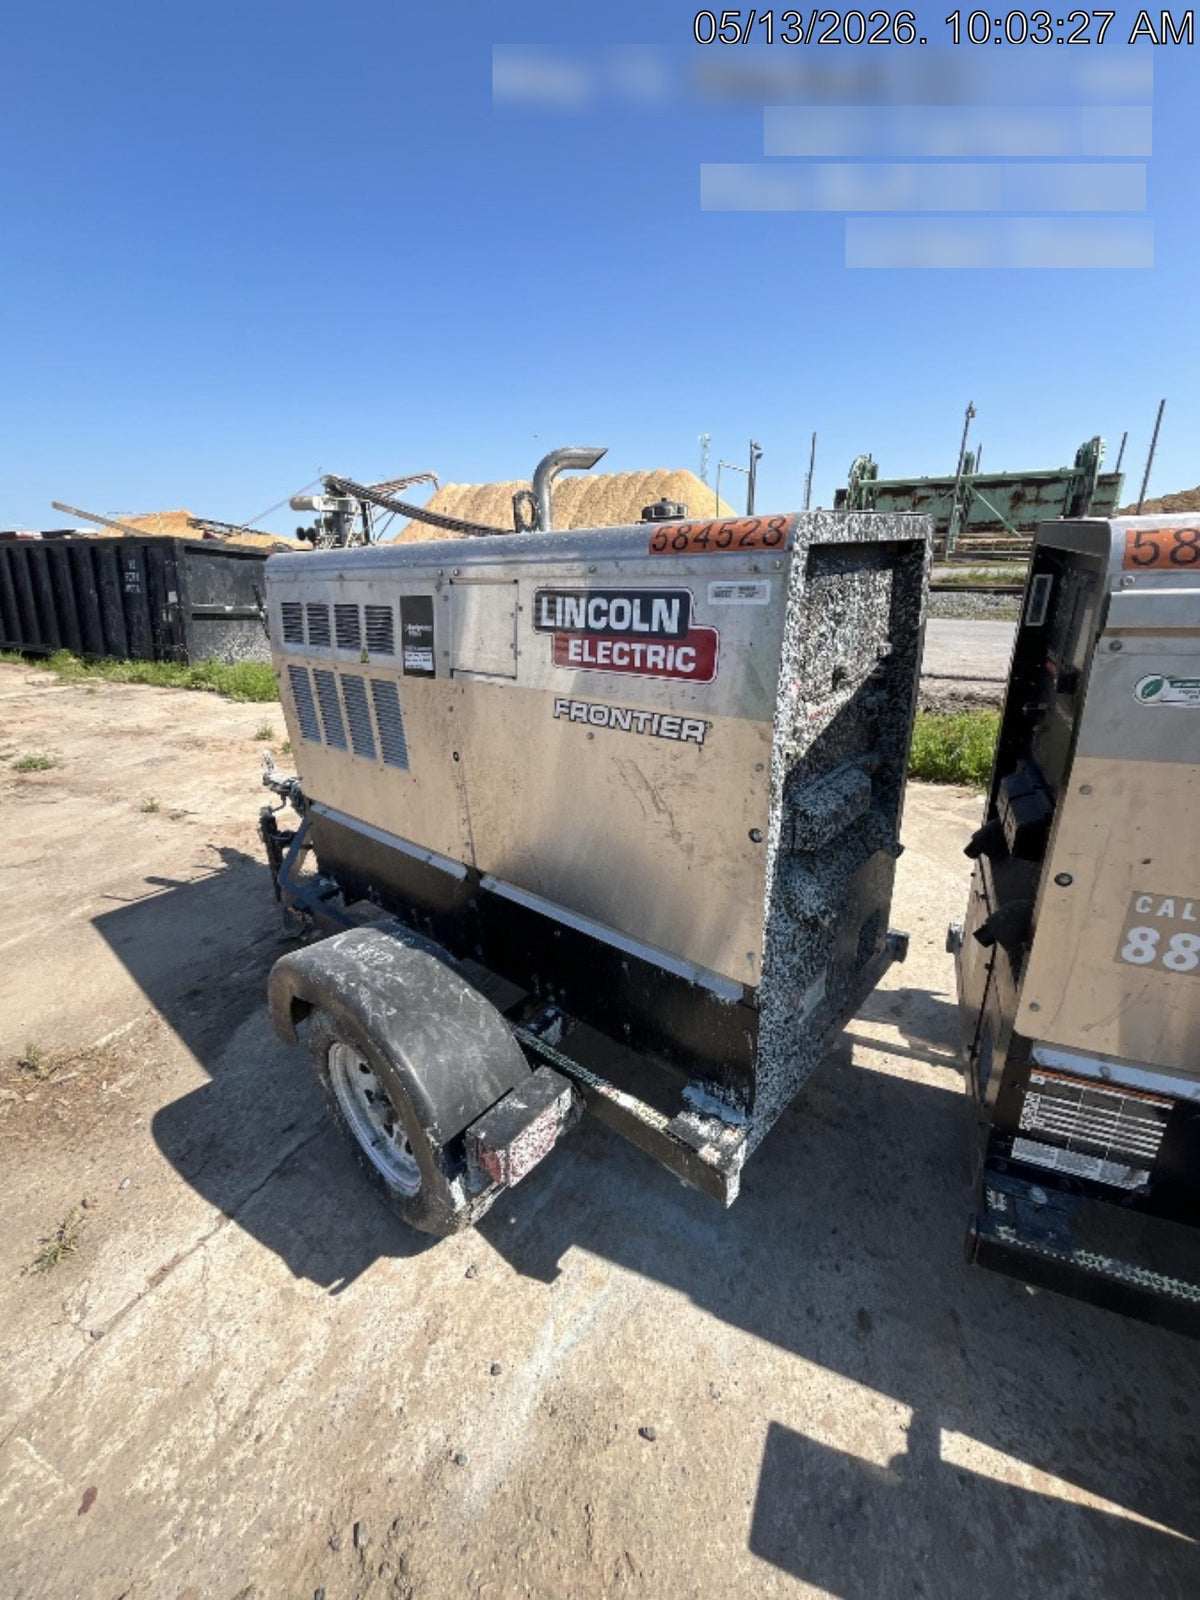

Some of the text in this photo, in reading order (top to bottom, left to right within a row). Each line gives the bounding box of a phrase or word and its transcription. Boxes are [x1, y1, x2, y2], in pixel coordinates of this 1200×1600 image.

[652, 517, 787, 552] 584528
[539, 595, 681, 635] LINCOLN
[567, 639, 697, 674] ELECTRIC
[553, 698, 706, 745] FRONTIER
